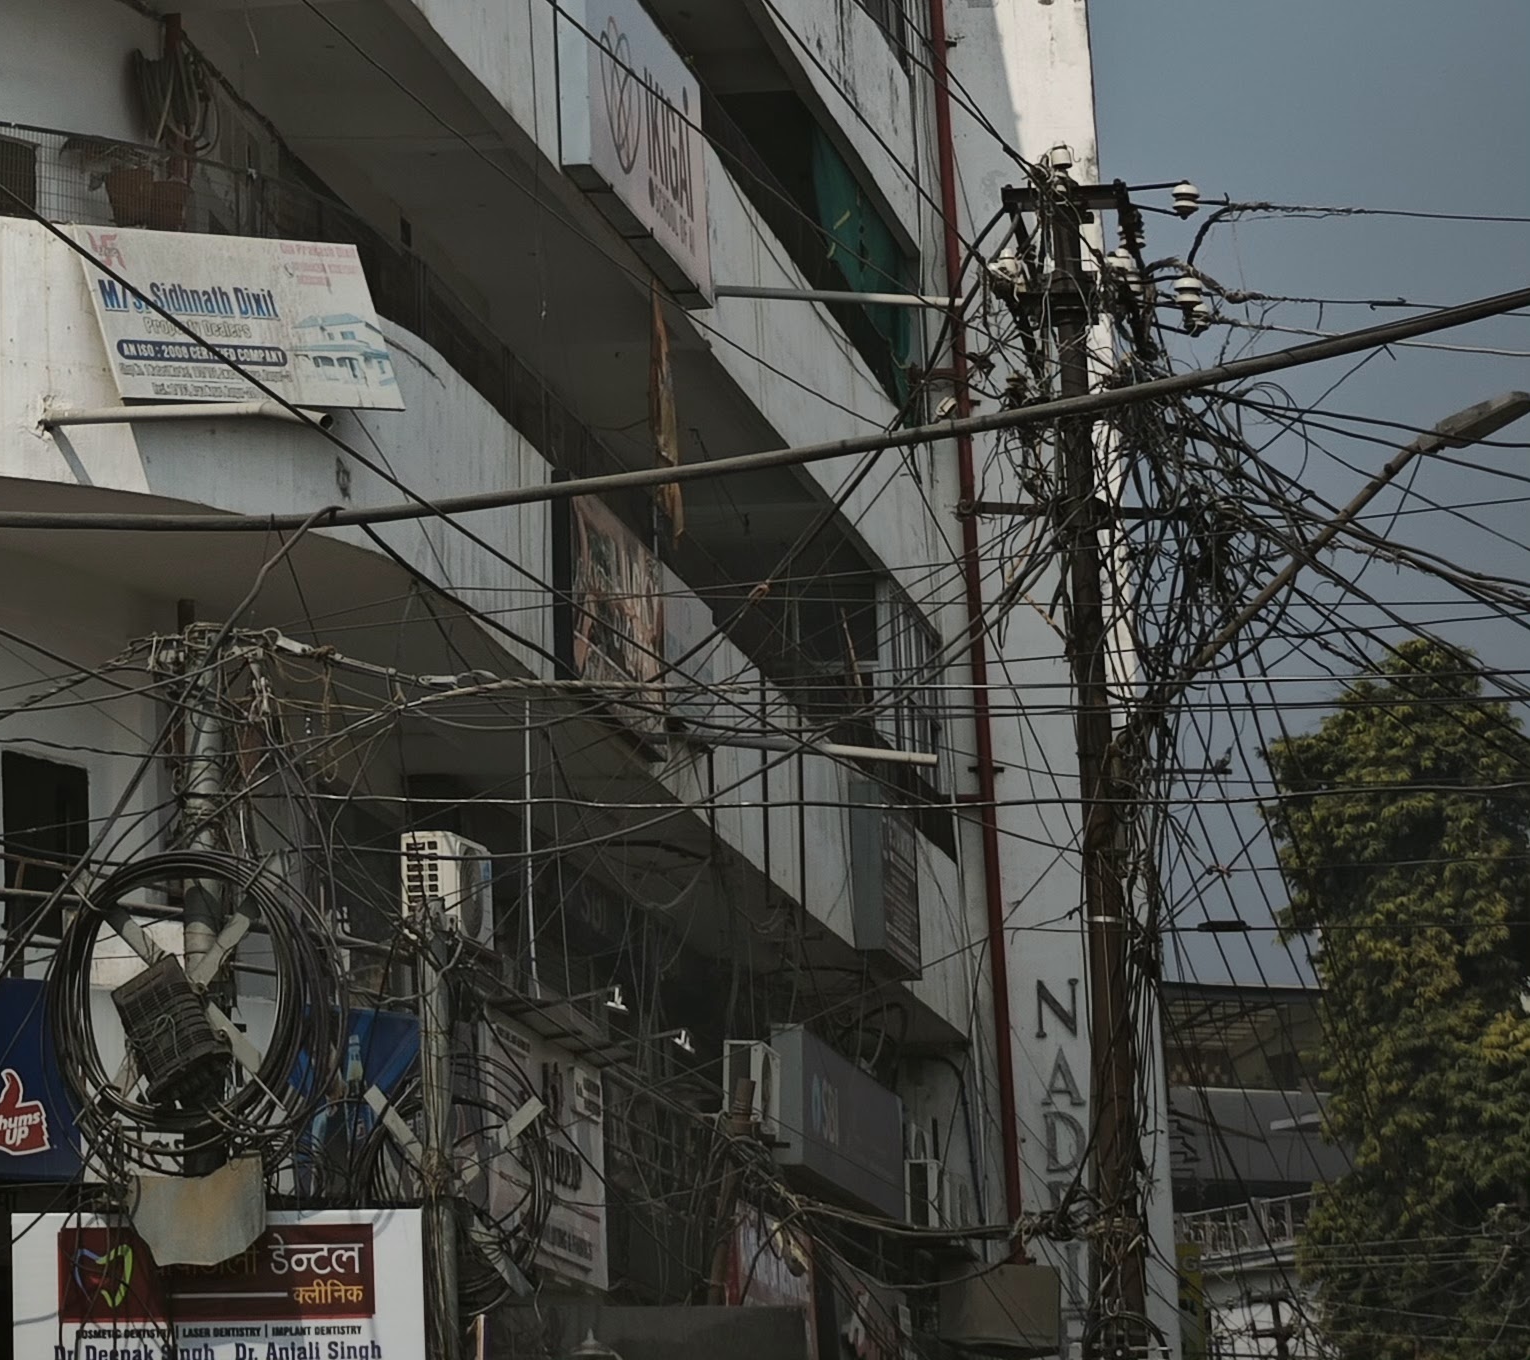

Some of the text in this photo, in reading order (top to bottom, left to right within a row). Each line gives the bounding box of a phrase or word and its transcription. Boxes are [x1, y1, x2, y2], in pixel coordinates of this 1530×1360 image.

[149, 282, 235, 318] Sidhnath
[233, 287, 281, 321] Dixit
[203, 320, 252, 338] Dealers
[237, 349, 285, 364] COMPANY
[5, 1126, 30, 1146] UP
[268, 1233, 365, 1275] डेन्टल
[293, 1278, 364, 1305] क्लीनिक
[182, 1327, 210, 1338] LASER
[213, 1327, 261, 1337] DENTISTRY
[272, 1326, 311, 1337] IMPLANT
[315, 1325, 362, 1336] DENTISTRY
[160, 1344, 215, 1360] Sngh
[266, 1341, 320, 1360] Anjali
[328, 1340, 382, 1360] Singh
